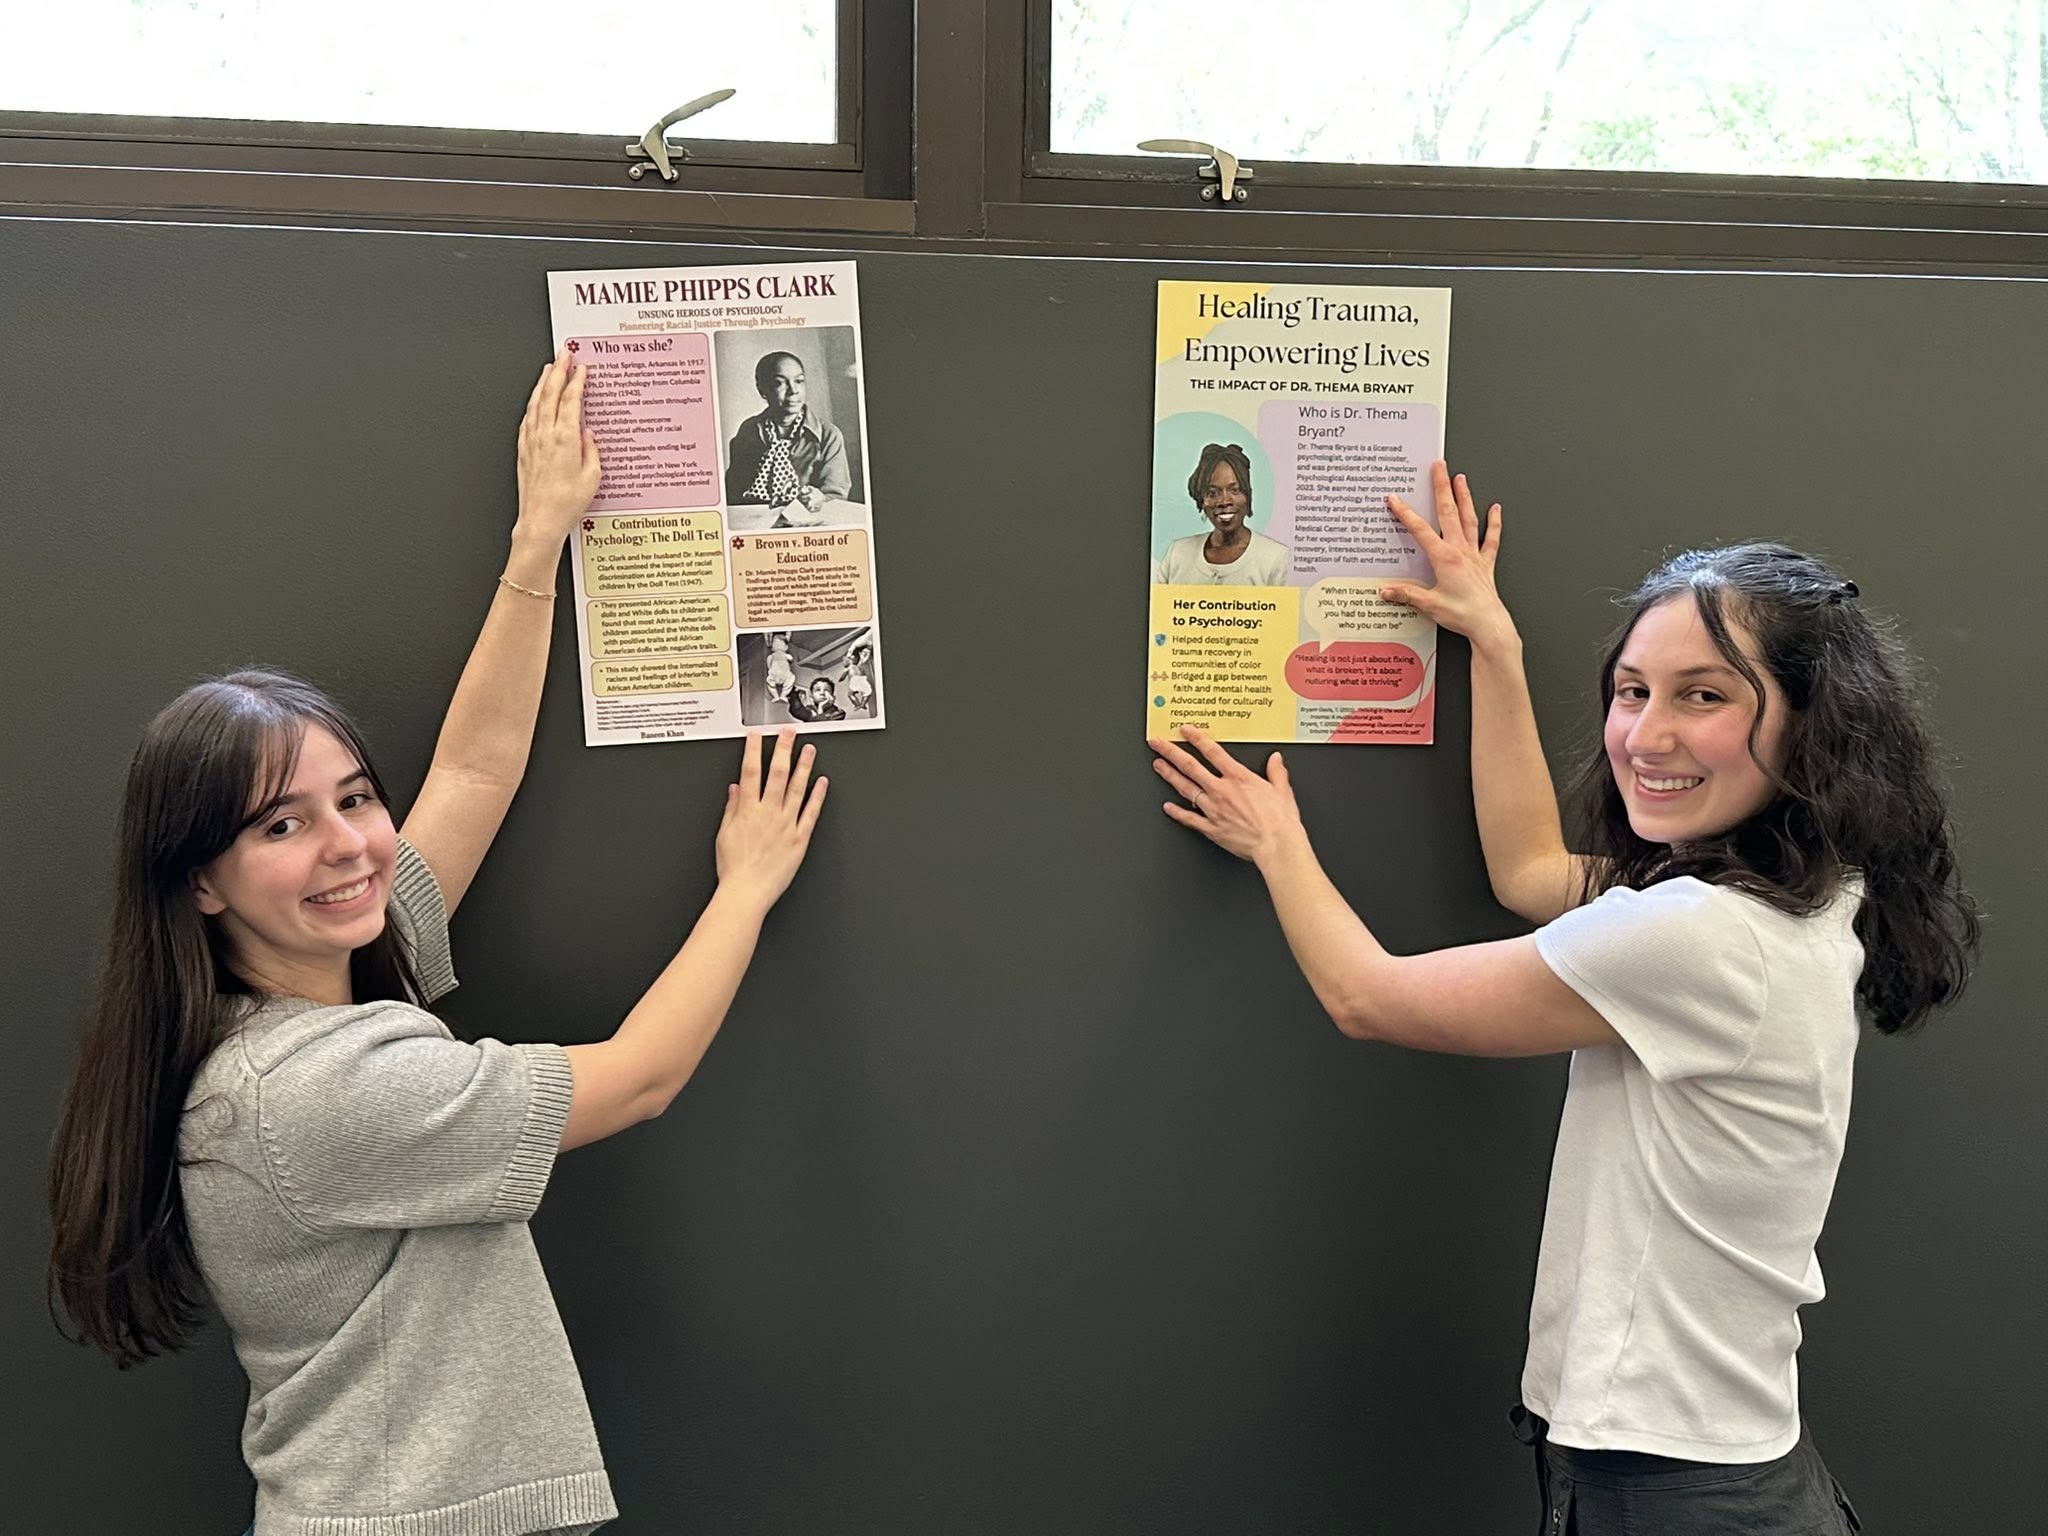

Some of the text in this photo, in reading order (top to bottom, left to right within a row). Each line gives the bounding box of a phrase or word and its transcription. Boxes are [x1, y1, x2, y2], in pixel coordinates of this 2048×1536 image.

[575, 274, 837, 305] MAMIE PHIPPS CLARK
[638, 305, 783, 319] UNSUNG HEROES OF PSYCHOLOGY
[1198, 293, 1419, 328] Healing Trauma,
[620, 316, 806, 331] Pioneering Racial Justice Through Psychology
[592, 338, 673, 353] Who was she?
[1185, 338, 1430, 373] Empowering Lives
[1190, 379, 1414, 393] THE IMPACT OF DR. THEMA BRYANT
[1299, 407, 1408, 420] Who is Dr. Thema
[1298, 426, 1345, 439] Bryant?
[1335, 444, 1358, 452] Bryant
[612, 517, 691, 530] Contribution to
[586, 530, 719, 548] Psychology: The Doll Test
[755, 539, 789, 549] Brown
[804, 536, 834, 547] Board
[838, 534, 848, 545] of
[654, 551, 681, 559] husband
[777, 552, 829, 563] Education
[599, 582, 625, 590] children
[627, 581, 635, 589] by
[1321, 587, 1347, 595] "When
[618, 600, 651, 608] presented
[1174, 600, 1276, 611] Her Contribution
[1318, 600, 1335, 608] you,
[1337, 600, 1347, 608] try
[748, 607, 762, 615] legal
[764, 606, 782, 614] school
[784, 605, 818, 613] segregation
[1341, 610, 1355, 618] had
[1173, 616, 1262, 629] to Psychology:
[1389, 622, 1402, 630] be"
[1172, 635, 1258, 646] Helped destigmatize
[1204, 650, 1240, 658] recovery
[1295, 654, 1327, 664] "Healing
[1352, 656, 1367, 664] just
[1393, 655, 1414, 664] fixing
[1172, 660, 1226, 668] communities
[1228, 660, 1237, 668] of
[1172, 672, 1204, 681] Bridged
[1213, 674, 1228, 682] gap
[1231, 672, 1267, 680] between
[1305, 678, 1338, 686] nurturing
[1369, 678, 1402, 687] thriving"
[1173, 684, 1192, 692] faith
[1213, 685, 1242, 693] mental
[1170, 697, 1216, 705] Advocated
[1232, 698, 1274, 707] culturally
[1171, 709, 1251, 719] responsive therapy
